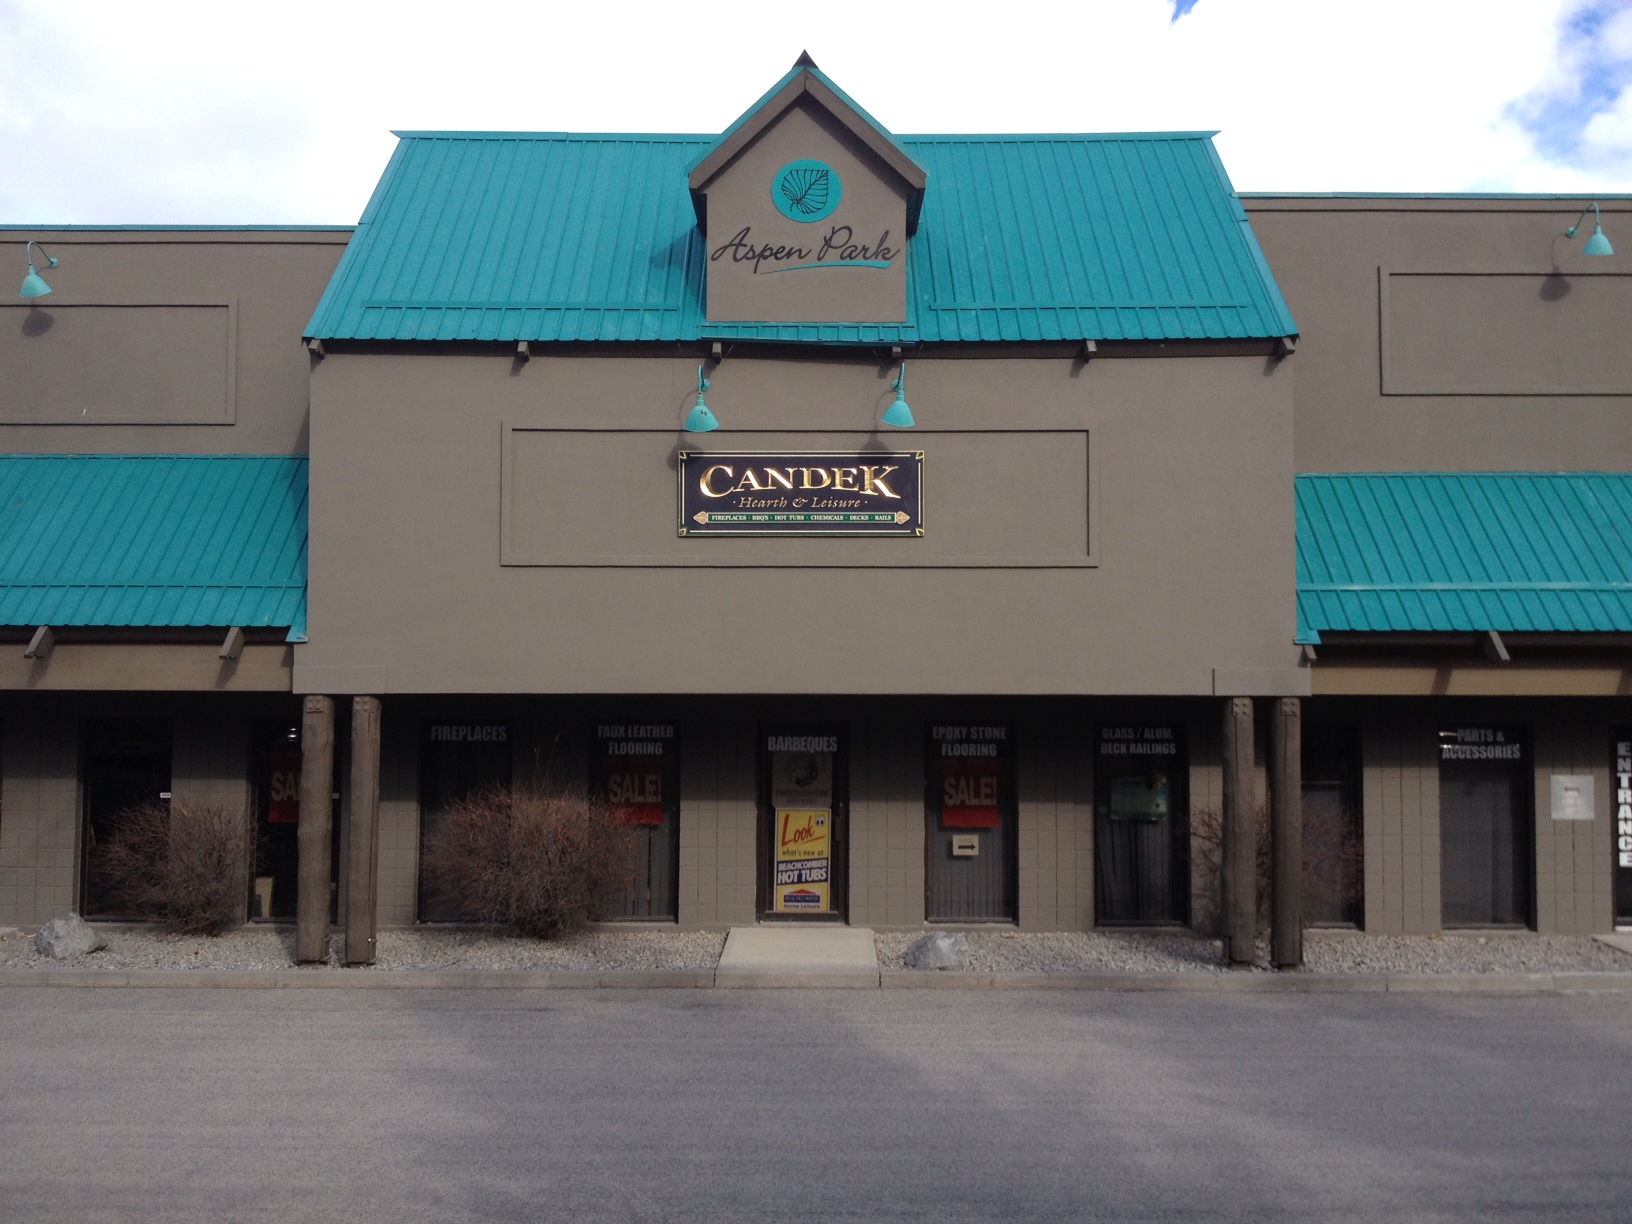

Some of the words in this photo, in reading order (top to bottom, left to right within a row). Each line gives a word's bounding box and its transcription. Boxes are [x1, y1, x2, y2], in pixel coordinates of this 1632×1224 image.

[711, 226, 812, 274] Aspen
[817, 225, 901, 261] Park
[699, 465, 901, 499] CANDEK
[738, 496, 788, 508] Hearth
[792, 497, 808, 508] &
[811, 496, 860, 508] Leisure
[431, 726, 507, 741] FIREPLACES
[598, 725, 626, 739] FAUX
[628, 725, 674, 739] LEATHER
[932, 726, 968, 740] EPOXY
[970, 726, 1007, 740] STONE
[1102, 728, 1135, 740] GLASS
[1136, 728, 1142, 740] /
[1143, 728, 1174, 740] ALUM.
[1457, 728, 1494, 742] PARTS
[1496, 731, 1504, 742] &
[608, 742, 663, 755] FLOORING
[767, 736, 838, 754] BARBEQUES
[941, 743, 997, 756] FLOORING
[1100, 742, 1127, 754] DECK
[1129, 742, 1176, 754] RAILINGS
[1442, 745, 1520, 759] ACCESSORIES
[608, 773, 662, 803] SALE!
[944, 776, 997, 806] SALE!
[1616, 742, 1632, 867] ENTRANCE
[781, 813, 815, 847] Look
[782, 848, 802, 857] what's
[778, 859, 828, 871] BEACHCOMBER
[777, 870, 799, 885] HOT
[801, 867, 827, 882] TUBS
